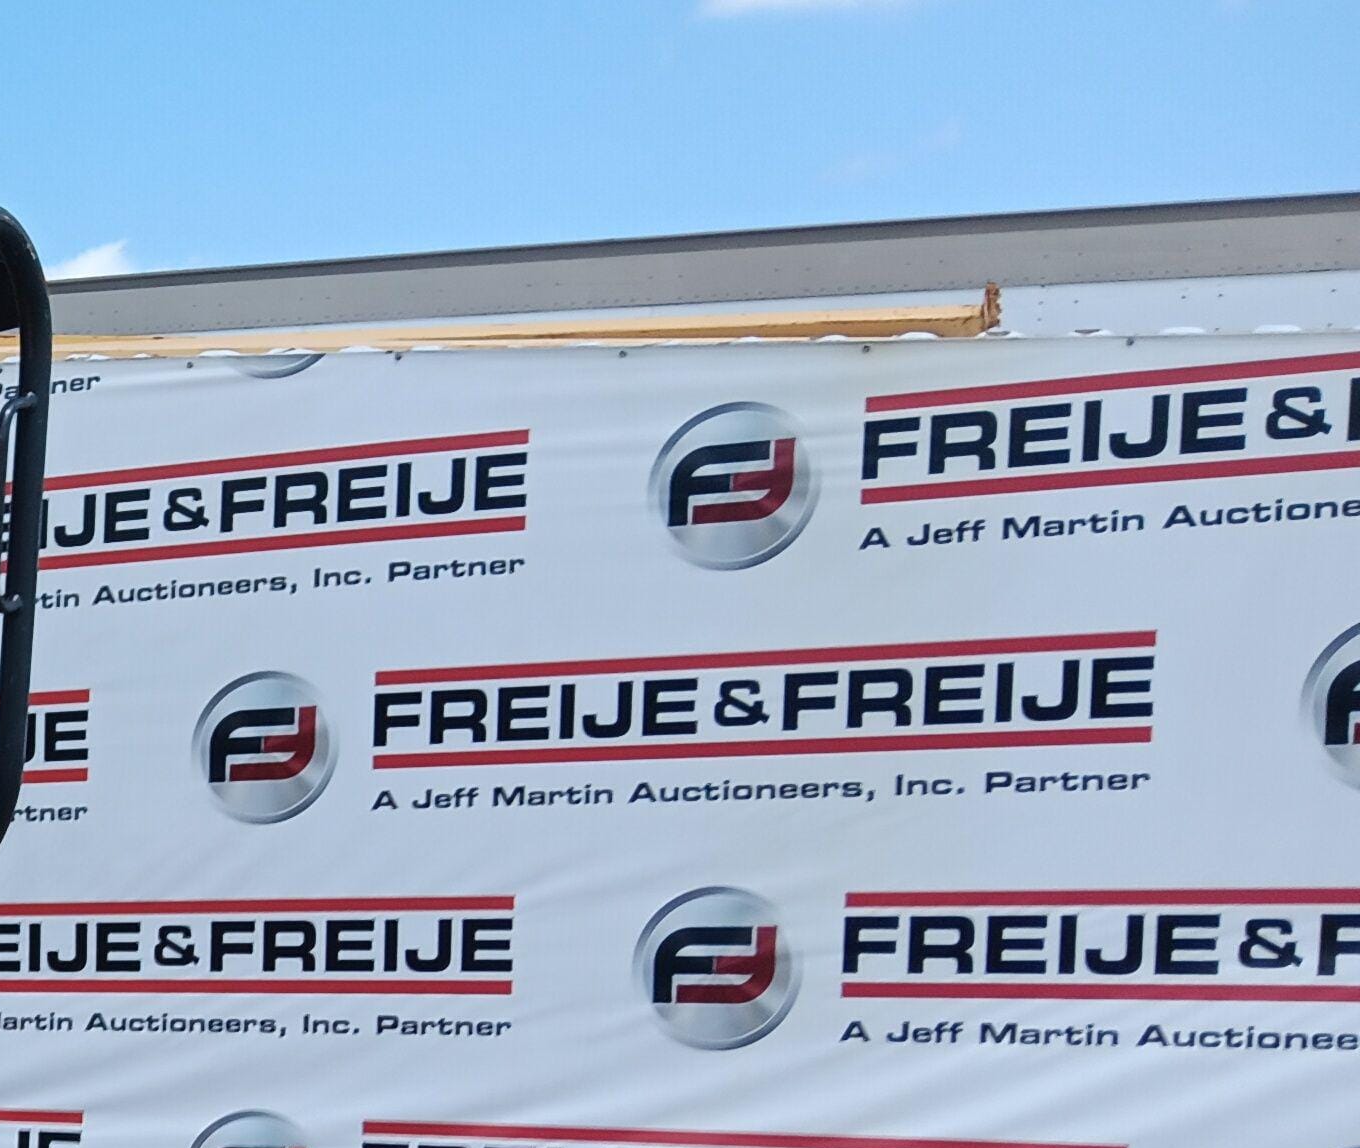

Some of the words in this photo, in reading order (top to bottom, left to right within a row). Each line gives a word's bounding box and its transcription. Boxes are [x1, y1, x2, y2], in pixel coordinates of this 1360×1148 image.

[861, 387, 1248, 480] FREIJE
[1265, 386, 1333, 440] &
[163, 487, 210, 532] &
[219, 451, 528, 533] FREIJE
[858, 526, 891, 551] A
[906, 518, 986, 547] Jeff
[1001, 509, 1145, 541] Martin
[91, 575, 298, 606] Auctioneers,
[313, 567, 372, 589] Inc.
[387, 558, 526, 583] Partner
[372, 677, 699, 748] FREIJE
[713, 679, 770, 727] &
[781, 655, 1155, 731] FREIJE
[370, 789, 399, 811] A
[411, 786, 480, 810] Jeff
[491, 783, 614, 808] Martin
[627, 779, 876, 804] Auctioneers,
[894, 773, 965, 797] Inc.
[984, 771, 1152, 794] Partner
[153, 925, 200, 967] &
[209, 917, 514, 973] FREIJE
[842, 913, 1221, 976] FREIJE
[1238, 918, 1303, 969] &
[84, 1012, 287, 1039] Auctioneers,
[302, 1013, 360, 1035] Inc.
[375, 1014, 513, 1037] Partner
[839, 1020, 871, 1043] A
[885, 1020, 964, 1044] Jeff
[978, 1022, 1119, 1047] Martin
